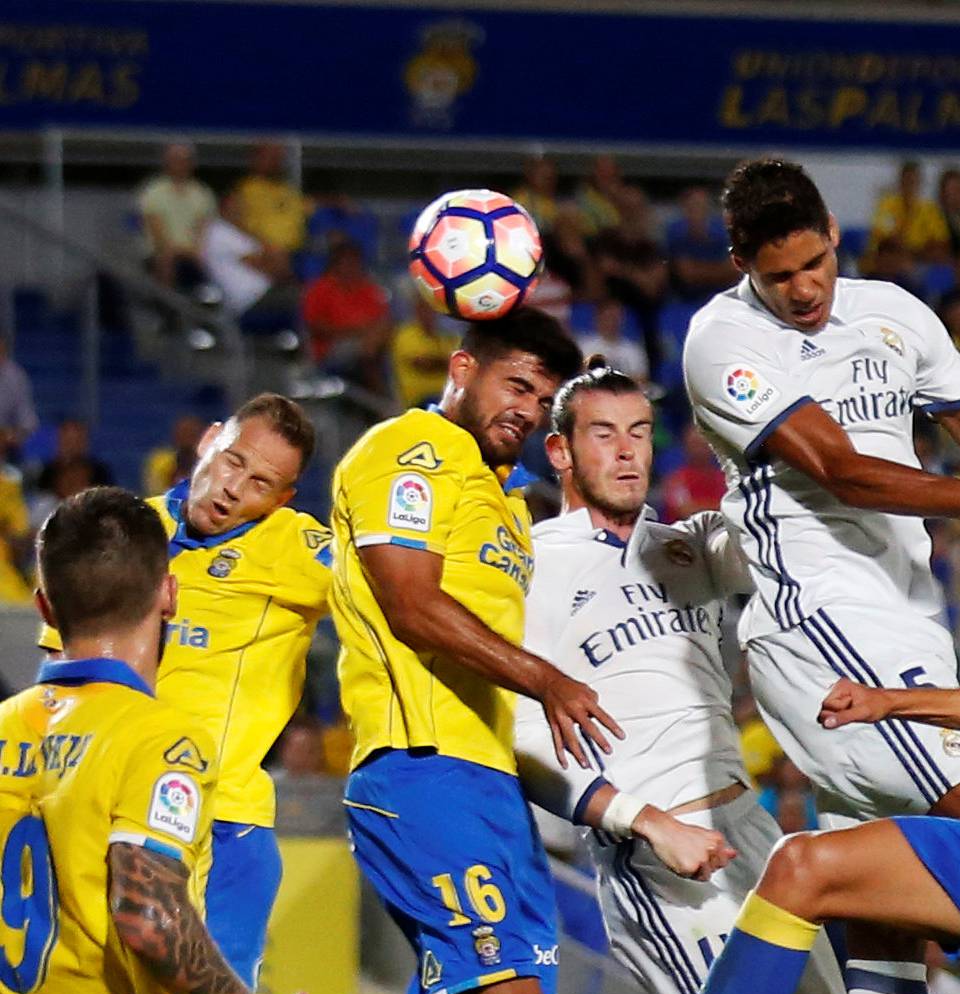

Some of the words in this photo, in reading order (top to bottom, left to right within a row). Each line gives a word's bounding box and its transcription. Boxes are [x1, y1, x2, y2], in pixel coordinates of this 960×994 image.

[851, 357, 888, 383] Fly
[620, 582, 669, 605] Fly
[579, 601, 713, 668] Emirate
[432, 864, 507, 926] 16
